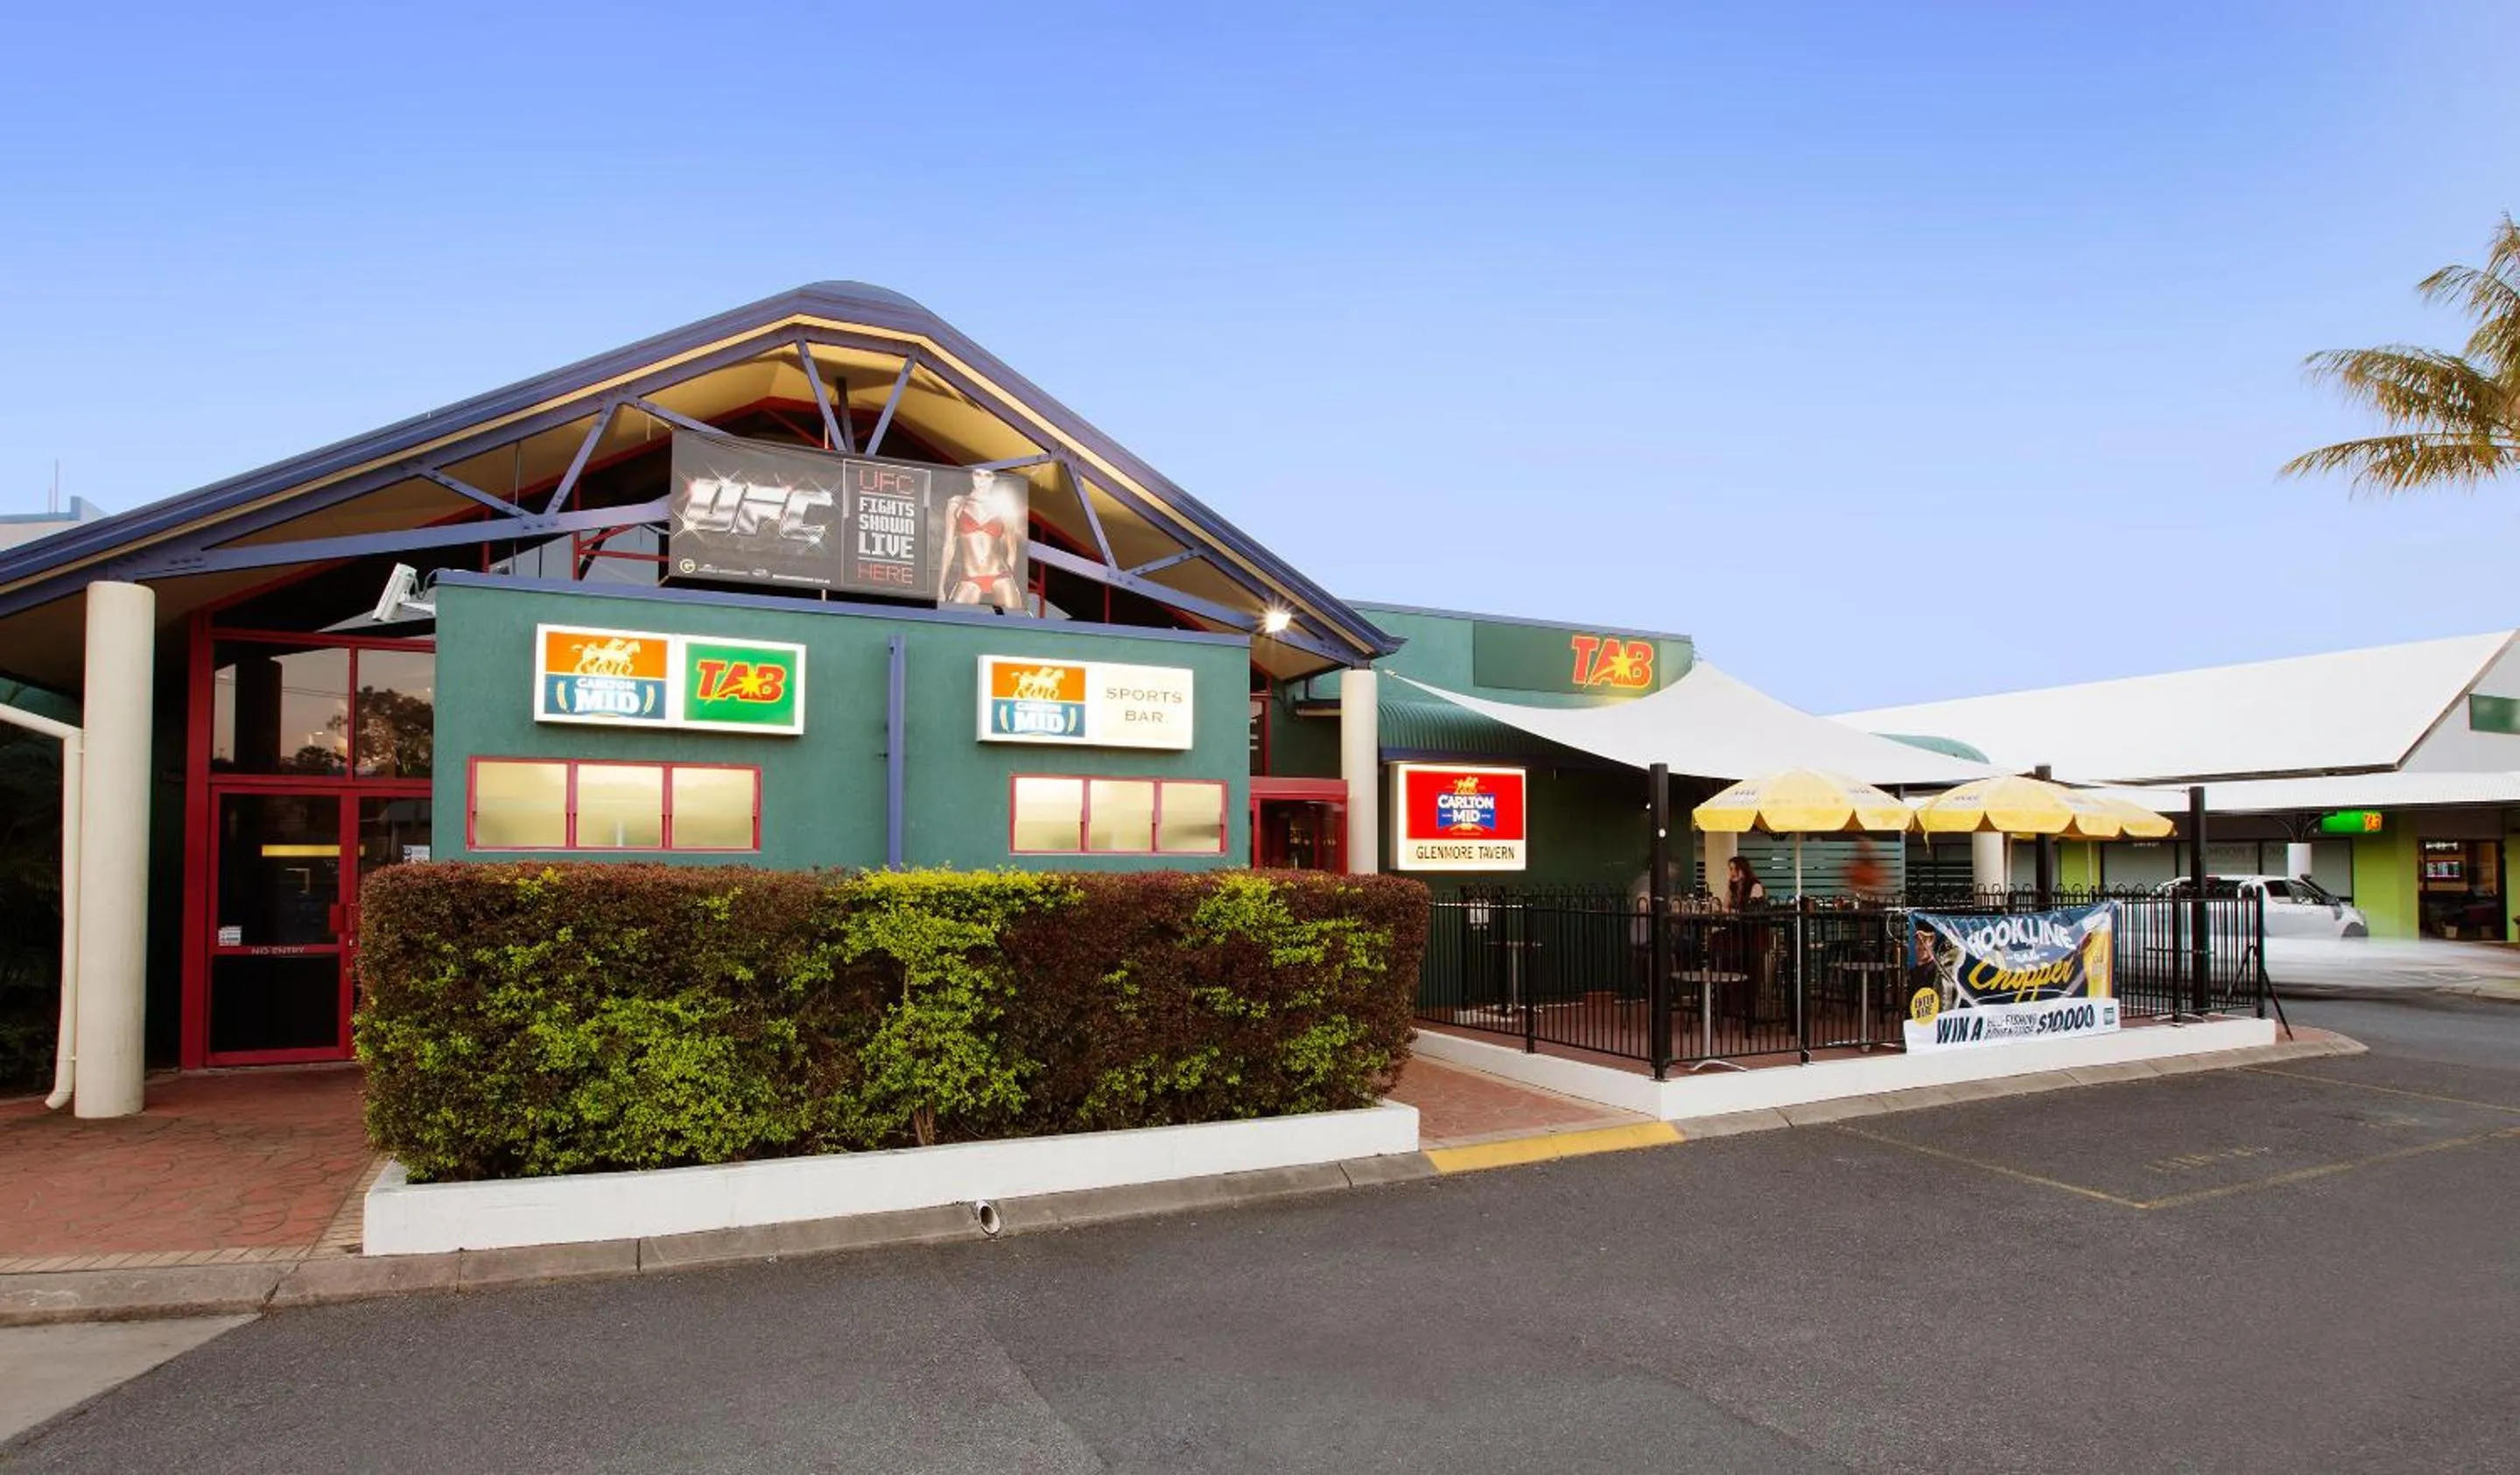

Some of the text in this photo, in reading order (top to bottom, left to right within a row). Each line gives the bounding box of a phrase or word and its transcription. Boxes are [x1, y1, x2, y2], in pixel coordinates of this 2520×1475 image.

[860, 469, 914, 495] UFC
[684, 477, 833, 543] UFC
[860, 496, 915, 516] FIGHTS
[859, 513, 915, 536] SHOWN
[859, 530, 915, 558] LIVE
[858, 563, 913, 585] HERE
[1572, 635, 1653, 689] TAB
[697, 659, 786, 704] TAB
[574, 687, 640, 714] MID
[1106, 686, 1183, 704] SPORTS
[1014, 710, 1065, 733] MID
[1125, 710, 1163, 723] BAR
[1438, 794, 1494, 809] CARLTON
[1453, 809, 1481, 822] MID
[1416, 846, 1515, 860] GLENMORE TAVERN
[271, 946, 305, 955] ENTRY
[1936, 1016, 1969, 1044] WIN
[1970, 1016, 1983, 1041] A
